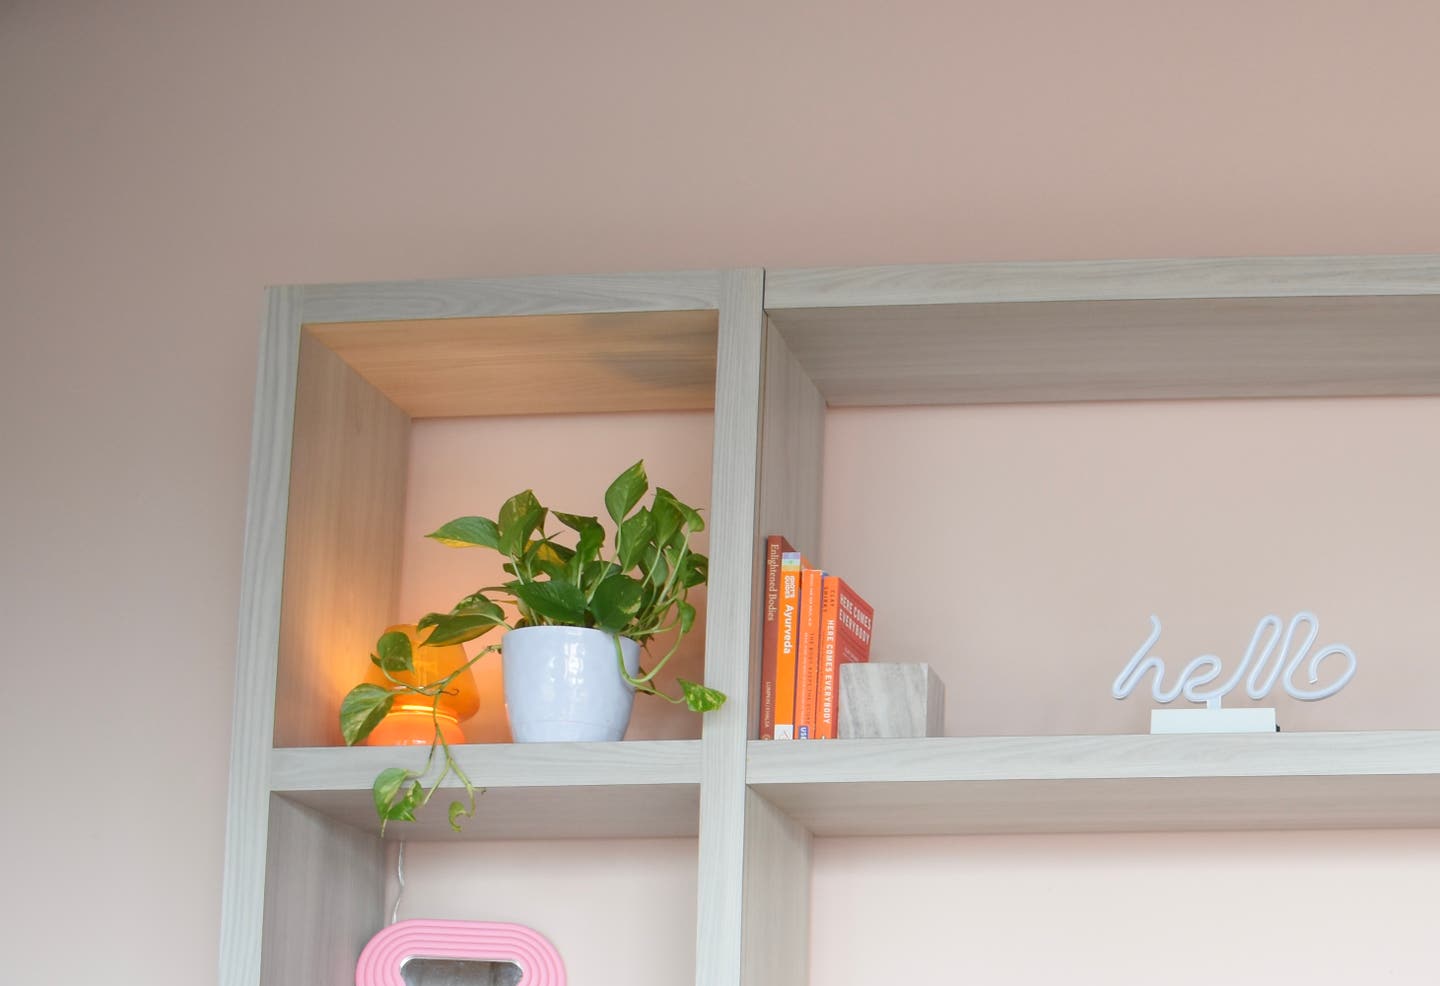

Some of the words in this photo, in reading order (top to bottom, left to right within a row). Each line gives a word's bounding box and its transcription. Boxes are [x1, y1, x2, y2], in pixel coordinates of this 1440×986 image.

[768, 543, 780, 592] Enlightened
[767, 593, 777, 621] Bodies
[839, 593, 854, 614] HERE
[853, 606, 872, 630] COMES
[839, 607, 870, 646] EVERYBODY
[783, 604, 795, 654] Ayurveda
[826, 620, 835, 641] HERE
[825, 644, 834, 672] COMES
[1111, 610, 1358, 703] hello
[823, 674, 833, 725] EVERYBODY
